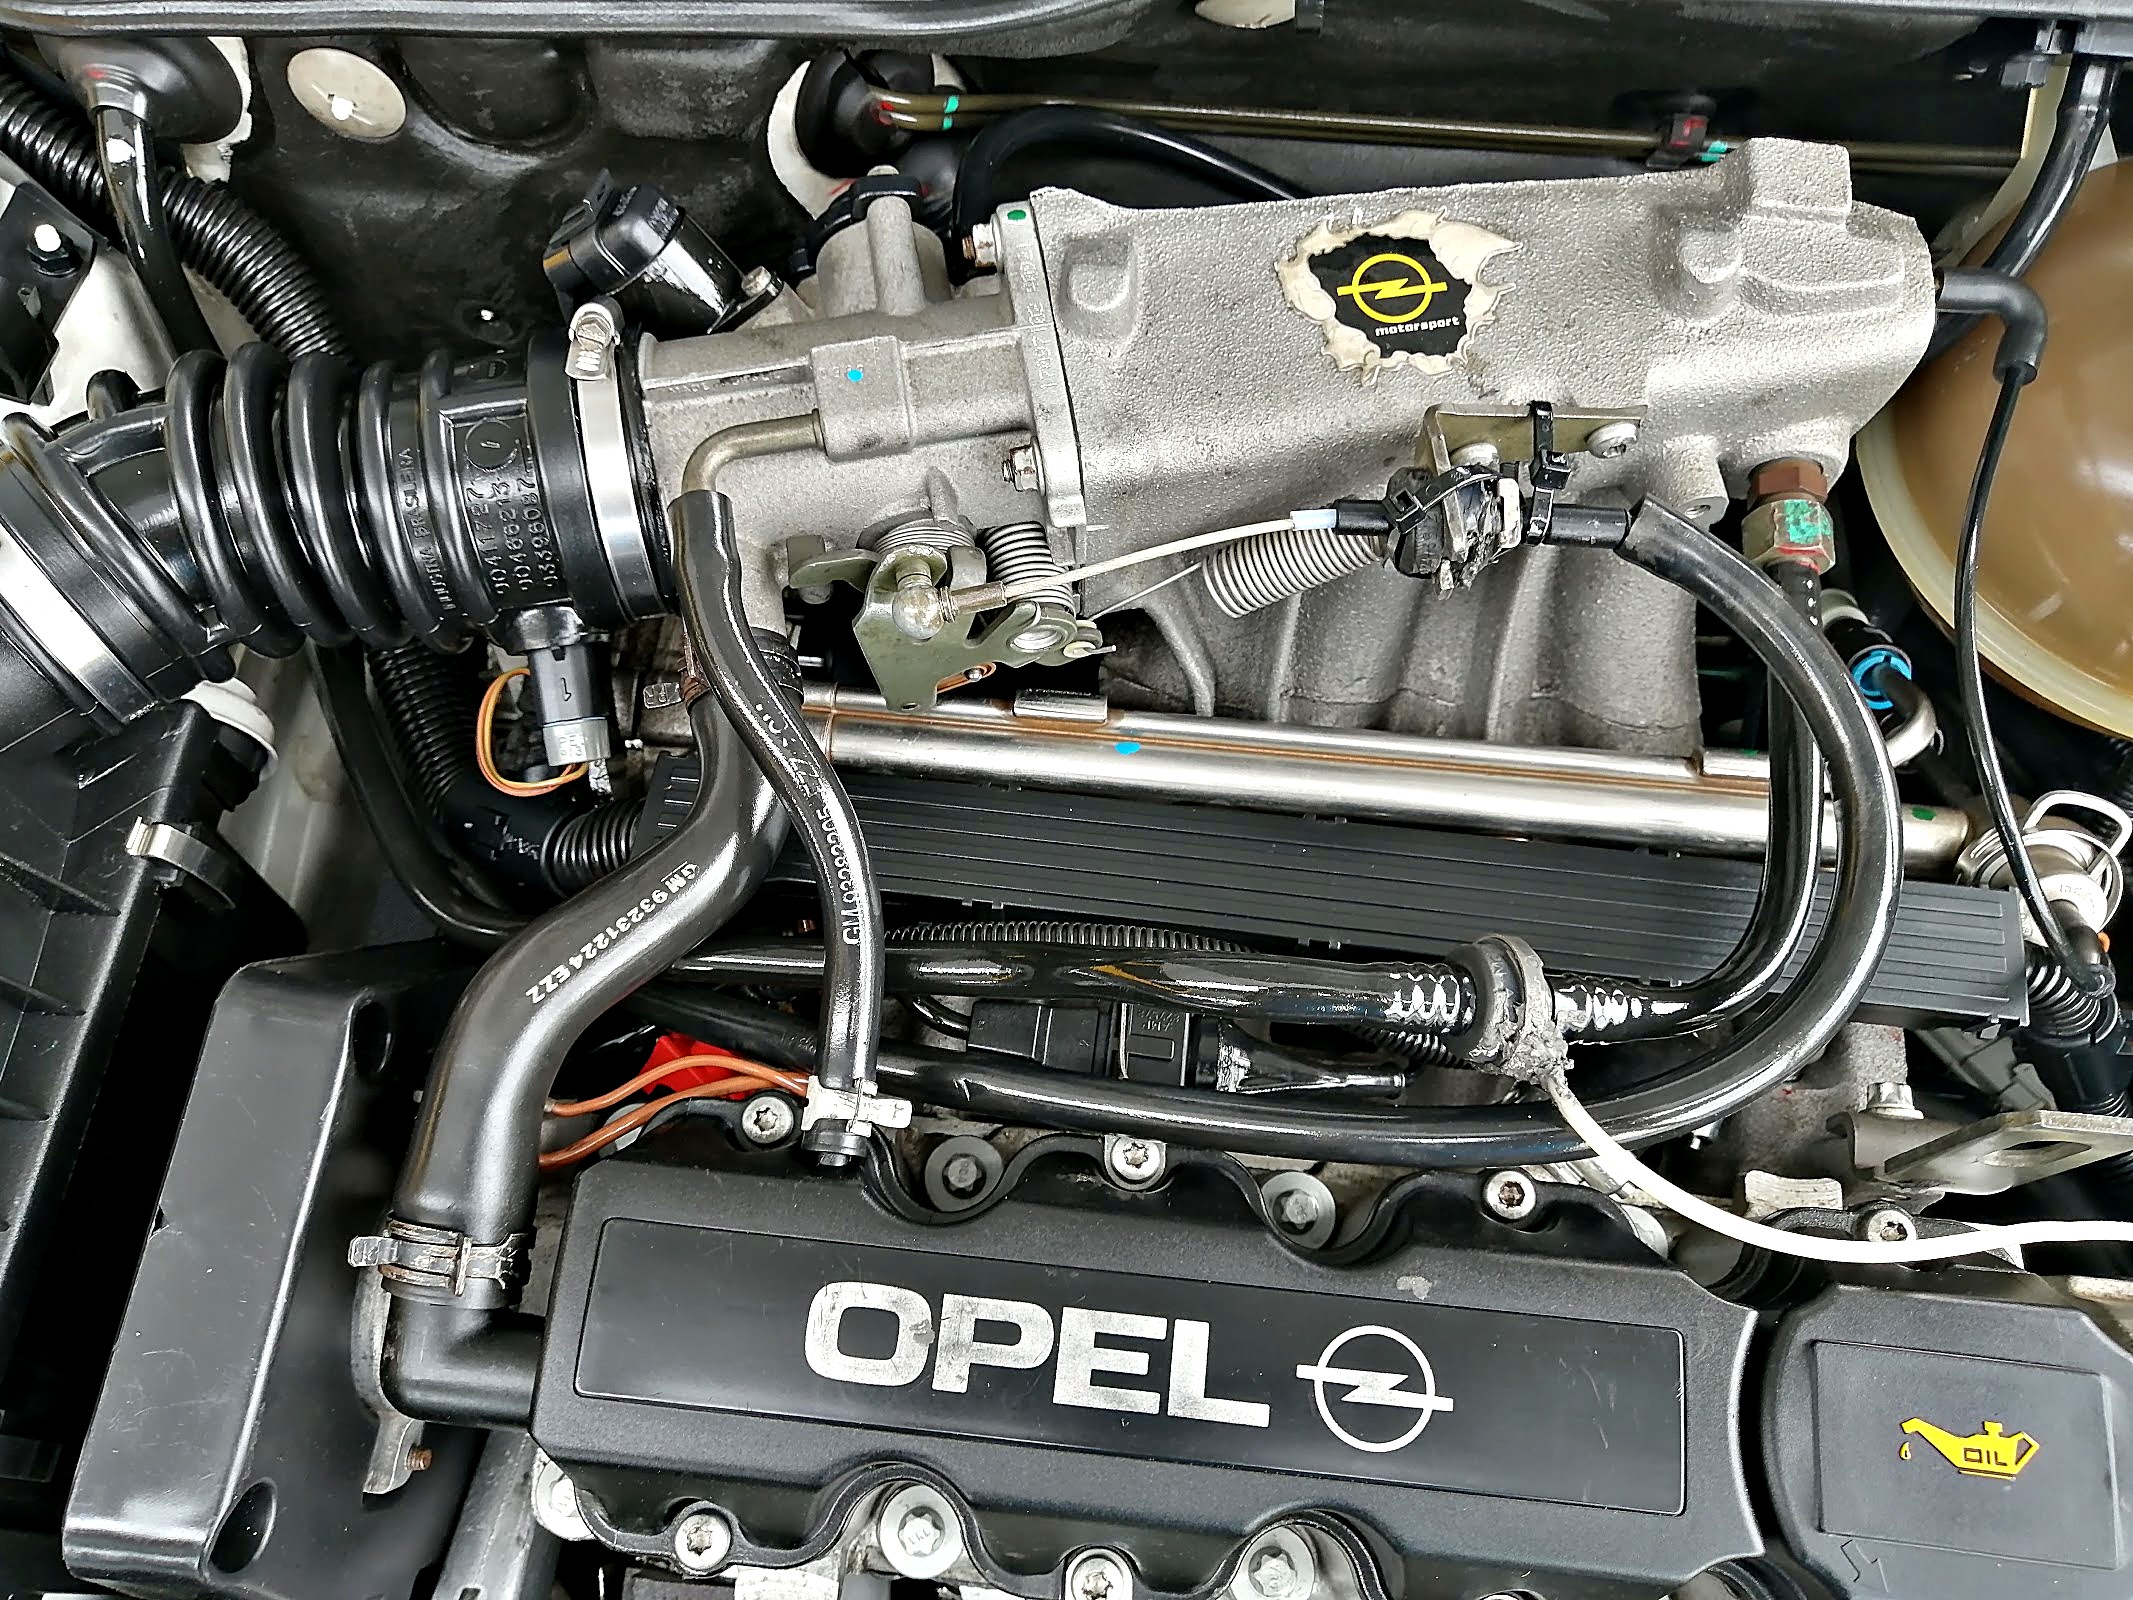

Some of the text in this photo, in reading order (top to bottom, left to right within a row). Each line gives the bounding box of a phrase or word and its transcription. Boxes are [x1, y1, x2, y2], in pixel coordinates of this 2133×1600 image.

[1374, 316, 1460, 337] motorsport
[803, 1280, 1271, 1428] OPEL
[1963, 1447, 2008, 1467] OIL
